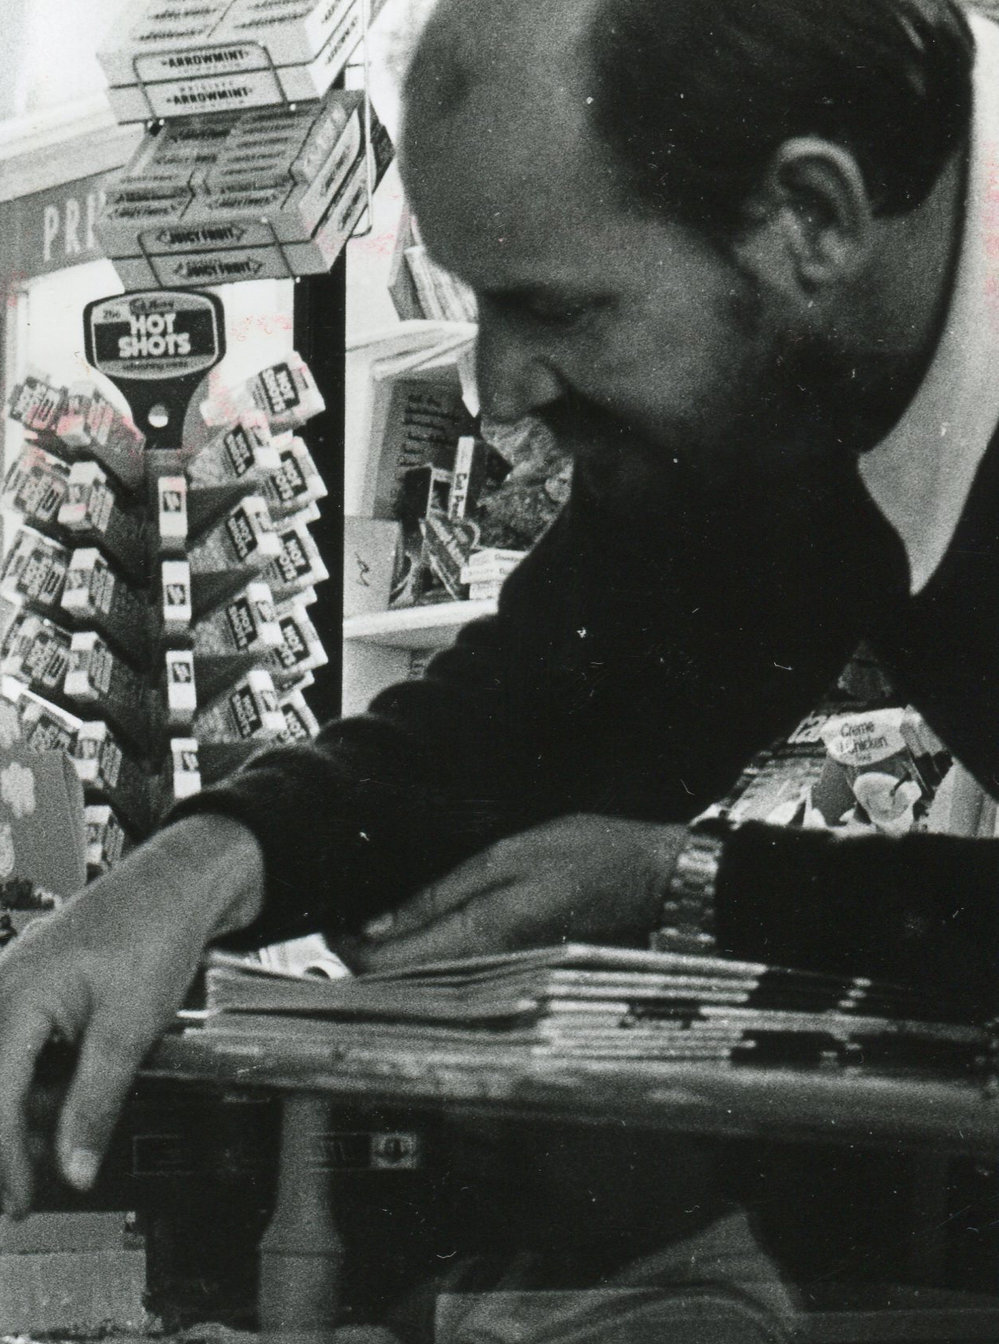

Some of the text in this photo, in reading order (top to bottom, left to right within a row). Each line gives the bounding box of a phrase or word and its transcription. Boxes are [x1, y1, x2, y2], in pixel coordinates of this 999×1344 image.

[168, 49, 244, 68] ARROWMINT
[173, 87, 249, 105] ARROWMINT
[129, 312, 177, 336] HOT
[118, 332, 192, 358] SHOTS
